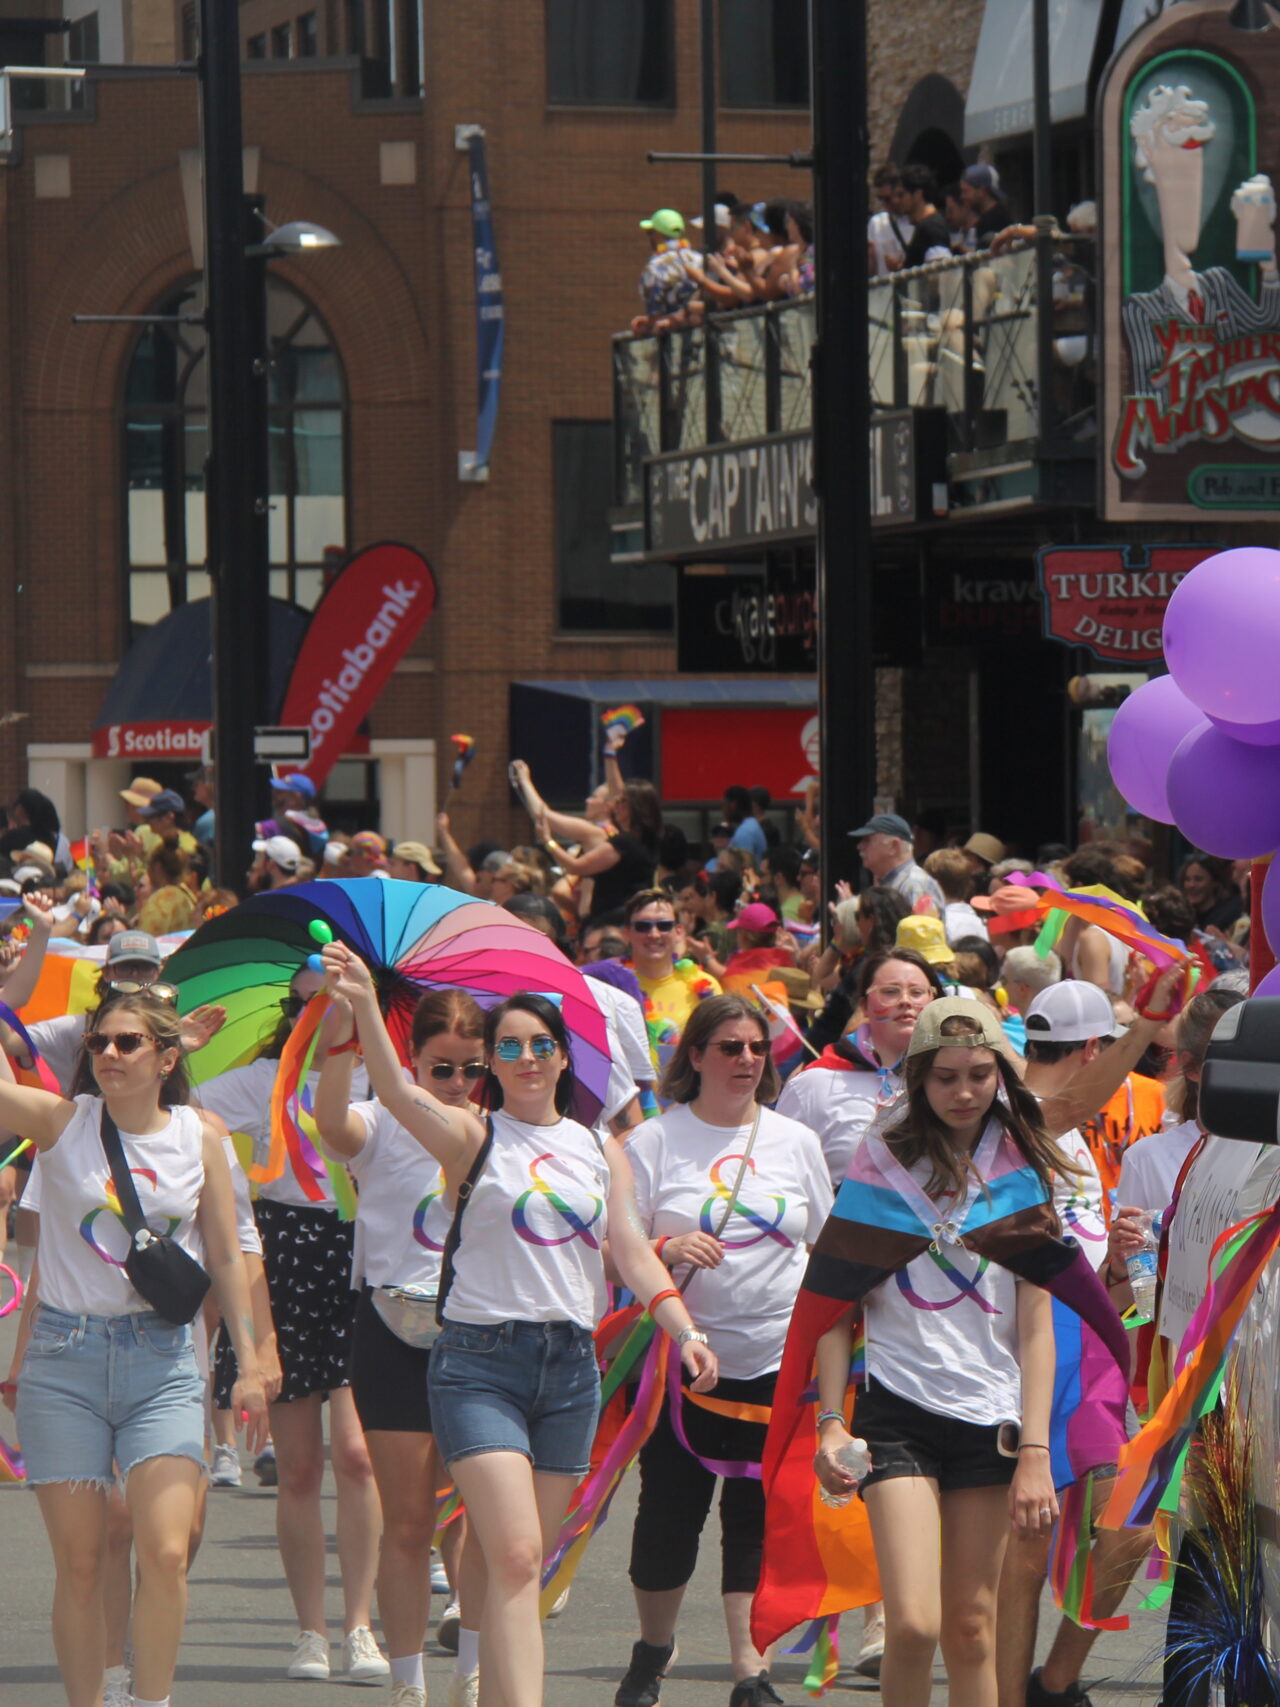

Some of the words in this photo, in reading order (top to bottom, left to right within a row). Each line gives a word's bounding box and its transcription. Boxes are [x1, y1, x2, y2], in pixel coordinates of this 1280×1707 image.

[667, 460, 690, 500] THE
[1204, 477, 1231, 498] Pub
[1074, 614, 1163, 650] DELIG
[297, 579, 418, 769] cotiabank
[125, 728, 202, 751] Scotiab
